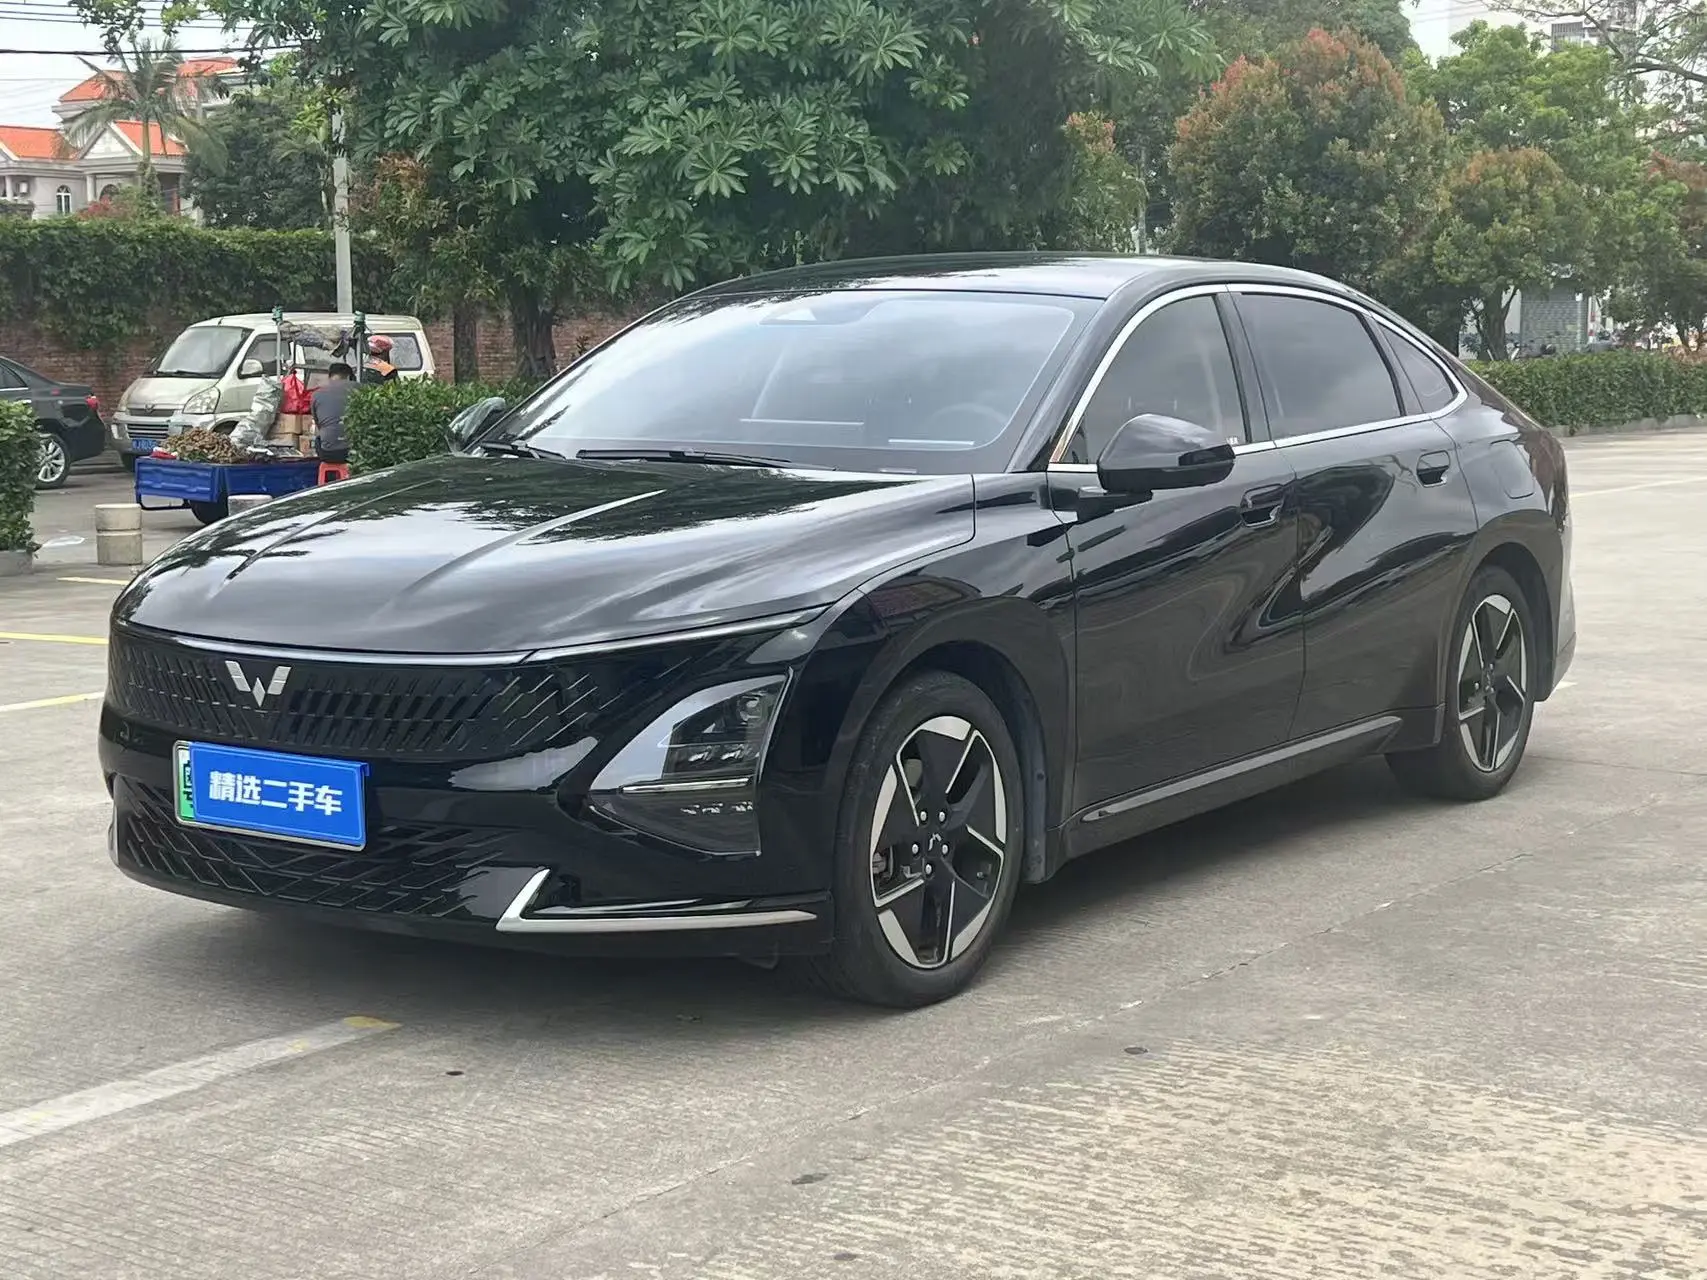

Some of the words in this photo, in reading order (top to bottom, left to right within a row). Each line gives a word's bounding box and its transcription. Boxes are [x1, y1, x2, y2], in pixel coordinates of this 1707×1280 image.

[208, 771, 343, 816] 精选二手车
